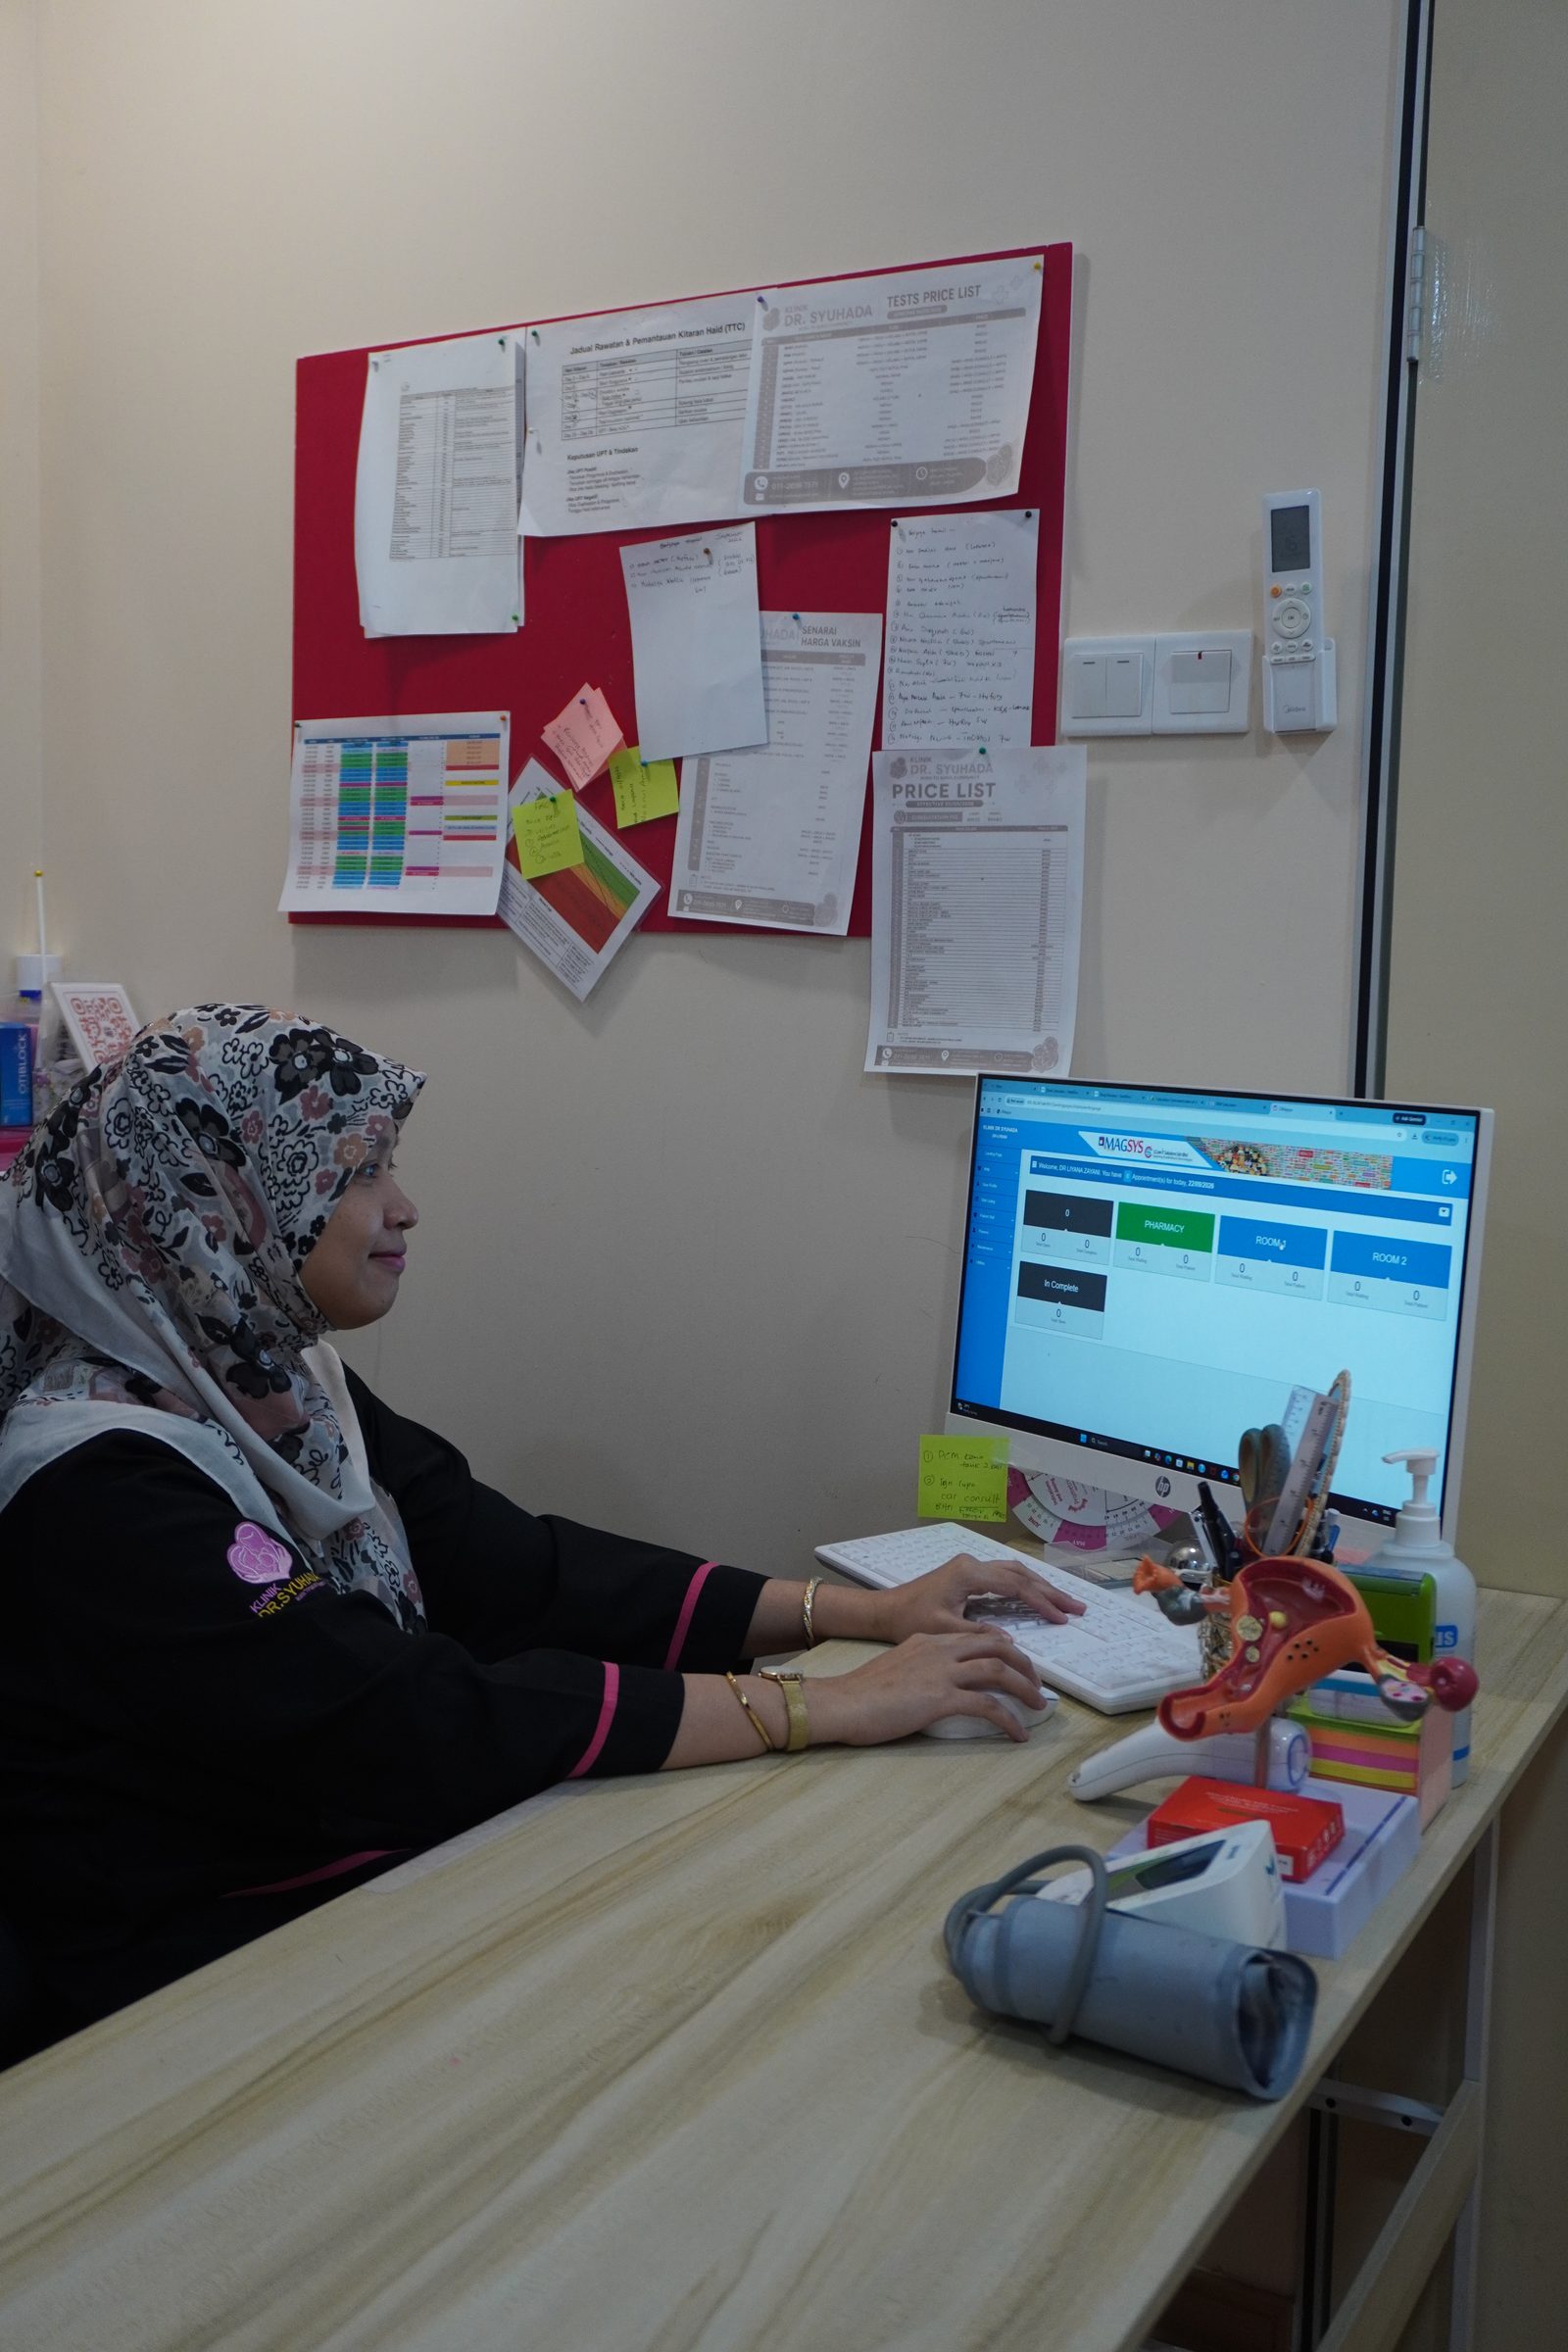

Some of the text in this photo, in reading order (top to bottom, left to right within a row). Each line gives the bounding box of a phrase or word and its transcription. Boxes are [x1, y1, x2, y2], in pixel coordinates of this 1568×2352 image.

[887, 284, 982, 309] TESTS PRICE LIST
[784, 314, 806, 327] DR.
[809, 305, 873, 323] SYUHADA
[570, 322, 746, 355] Jadual Rawatan & Pemantauan Kitaran Haid (TTC)
[566, 452, 596, 462] Keputusan
[613, 446, 639, 455] Tindakan
[761, 625, 837, 641] HADA SENARAI
[801, 637, 861, 648] HARGA VAKSIN
[910, 762, 994, 775] DR. SYUHADA
[892, 782, 997, 800] PRICE LIST
[18, 1034, 27, 1095] OTIBLOCK
[1103, 1136, 1144, 1154] MAGSYS
[1038, 1162, 1058, 1173] Welcome,
[1065, 1208, 1070, 1217] 0
[1144, 1219, 1186, 1234] PHARMACY
[1041, 1232, 1047, 1242] 0
[1255, 1235, 1281, 1248] ROOM
[1085, 1239, 1090, 1249] 0
[1136, 1247, 1141, 1257] 0
[1183, 1254, 1189, 1264] 0
[1372, 1252, 1408, 1266] ROOM 2
[1239, 1262, 1246, 1273] 0
[1292, 1271, 1298, 1282] 0
[1044, 1279, 1079, 1294] In Complete
[1354, 1281, 1361, 1292] 0
[1413, 1290, 1420, 1301] 0
[1055, 1308, 1061, 1318] 0
[1155, 1476, 1172, 1498] hp
[963, 1491, 1001, 1504] consult
[1027, 1516, 1041, 1528] JUNE
[250, 1583, 282, 1614] KLINIK
